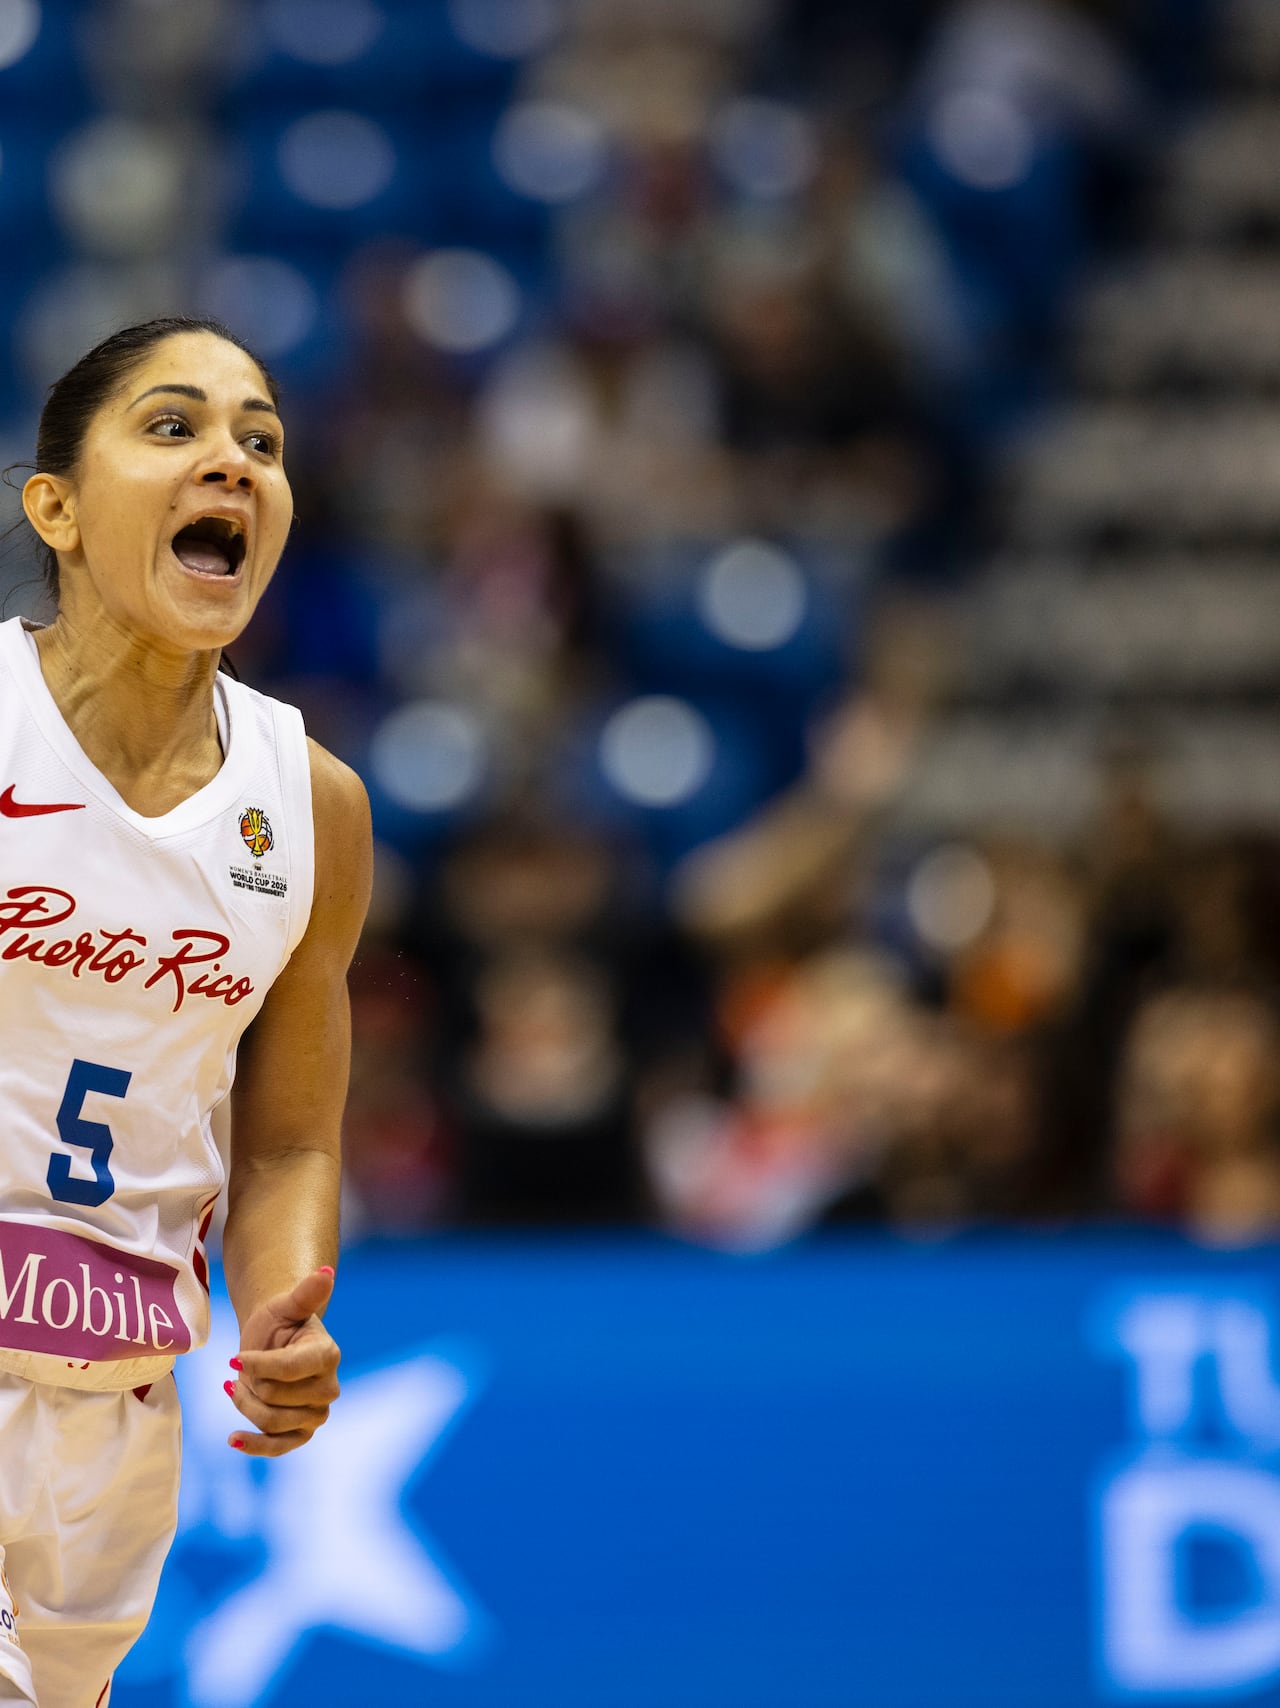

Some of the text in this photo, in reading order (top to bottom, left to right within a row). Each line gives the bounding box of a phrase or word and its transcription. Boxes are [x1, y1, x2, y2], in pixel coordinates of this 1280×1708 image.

[229, 865, 253, 876] WOMEN'S
[254, 871, 288, 884] BASKETBALL
[229, 871, 288, 892] WORLD CUP 2026
[144, 929, 255, 1012] Rico
[46, 1058, 133, 1208] 5
